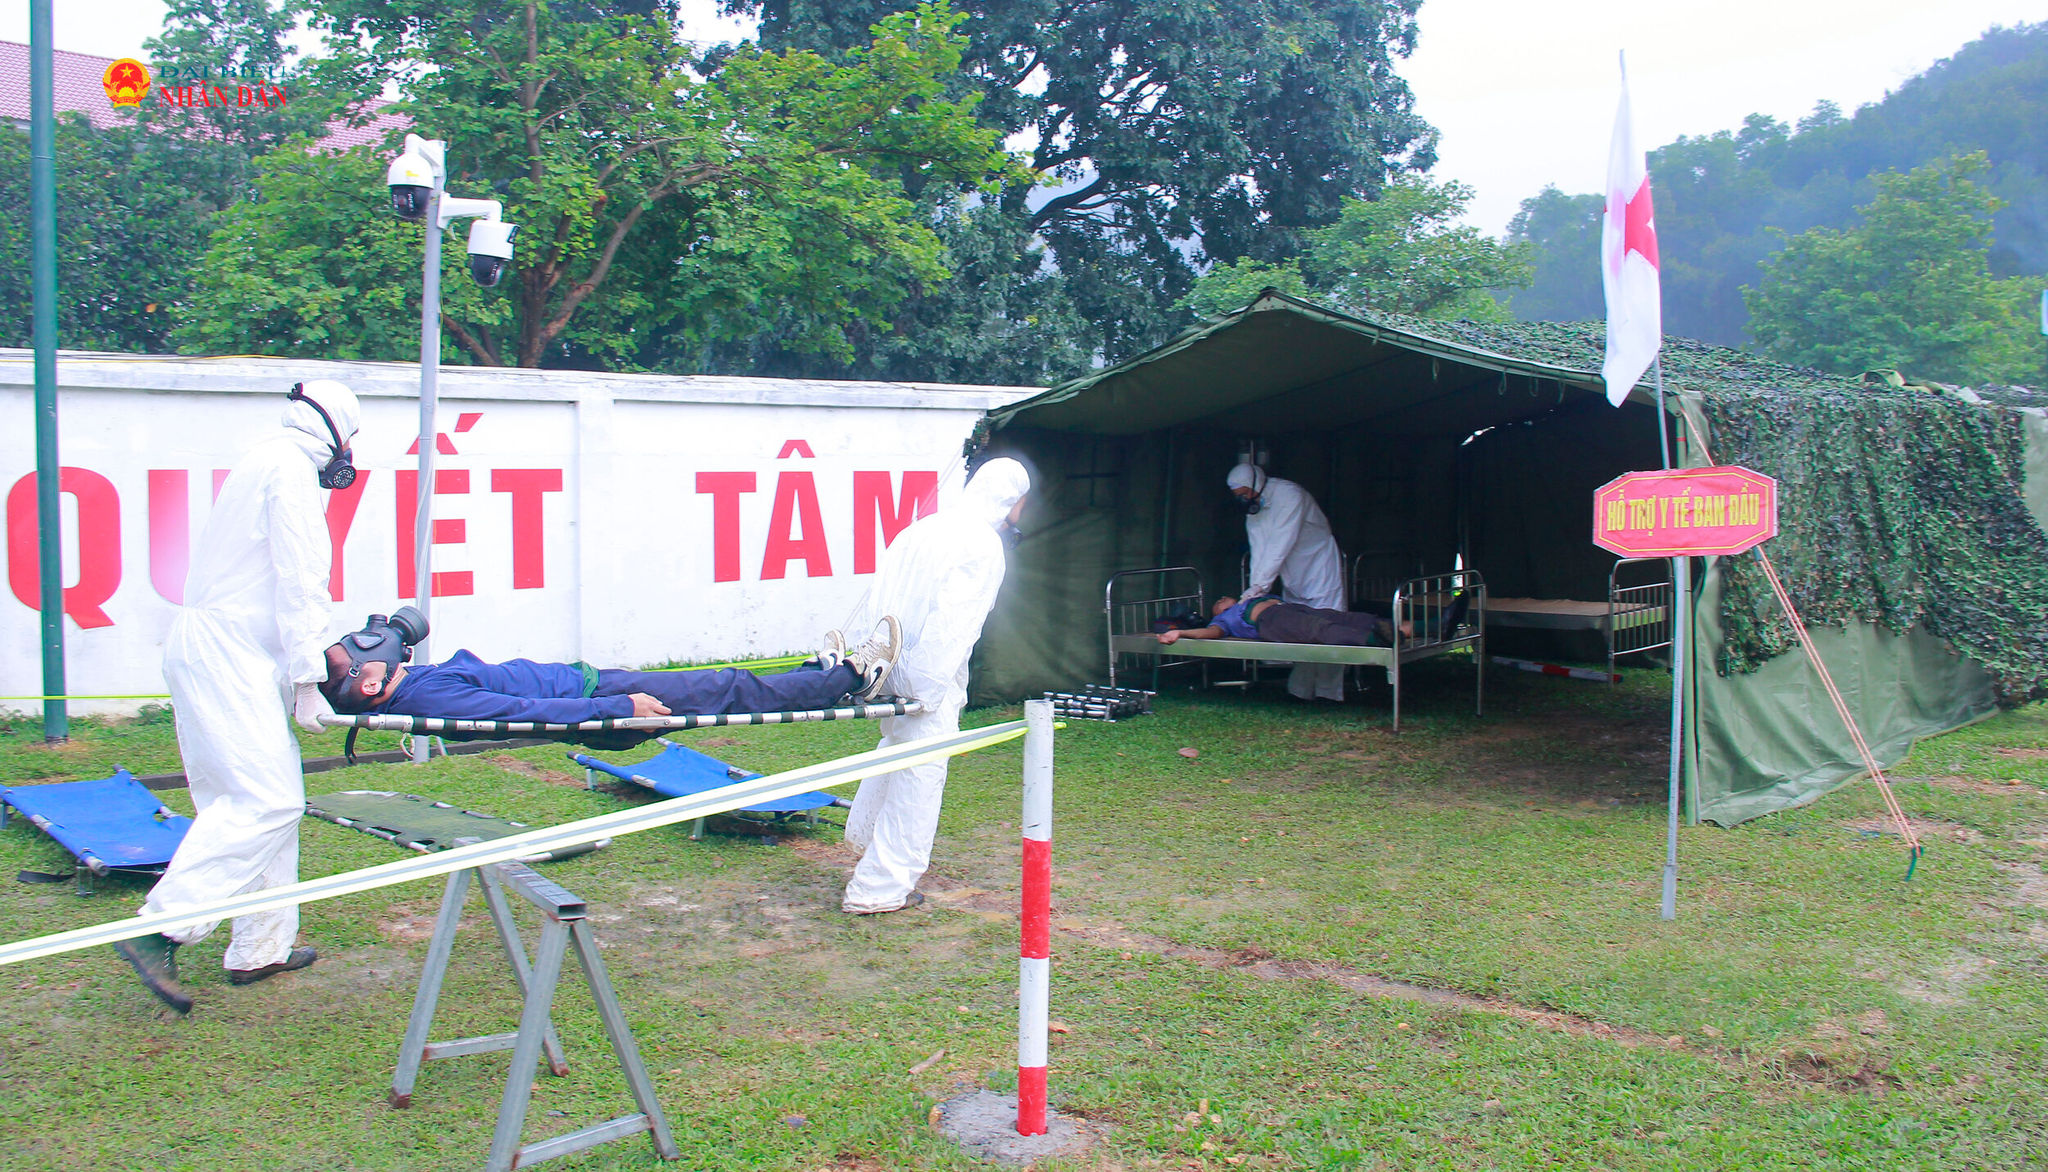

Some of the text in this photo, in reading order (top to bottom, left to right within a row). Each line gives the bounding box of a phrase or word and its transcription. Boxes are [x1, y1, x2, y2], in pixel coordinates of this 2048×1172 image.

[696, 440, 938, 583] TÂM
[1629, 495, 1657, 536] TRỢ
[1659, 498, 1669, 529] Y
[1672, 486, 1692, 528] TẾ
[1693, 495, 1725, 528] BAN
